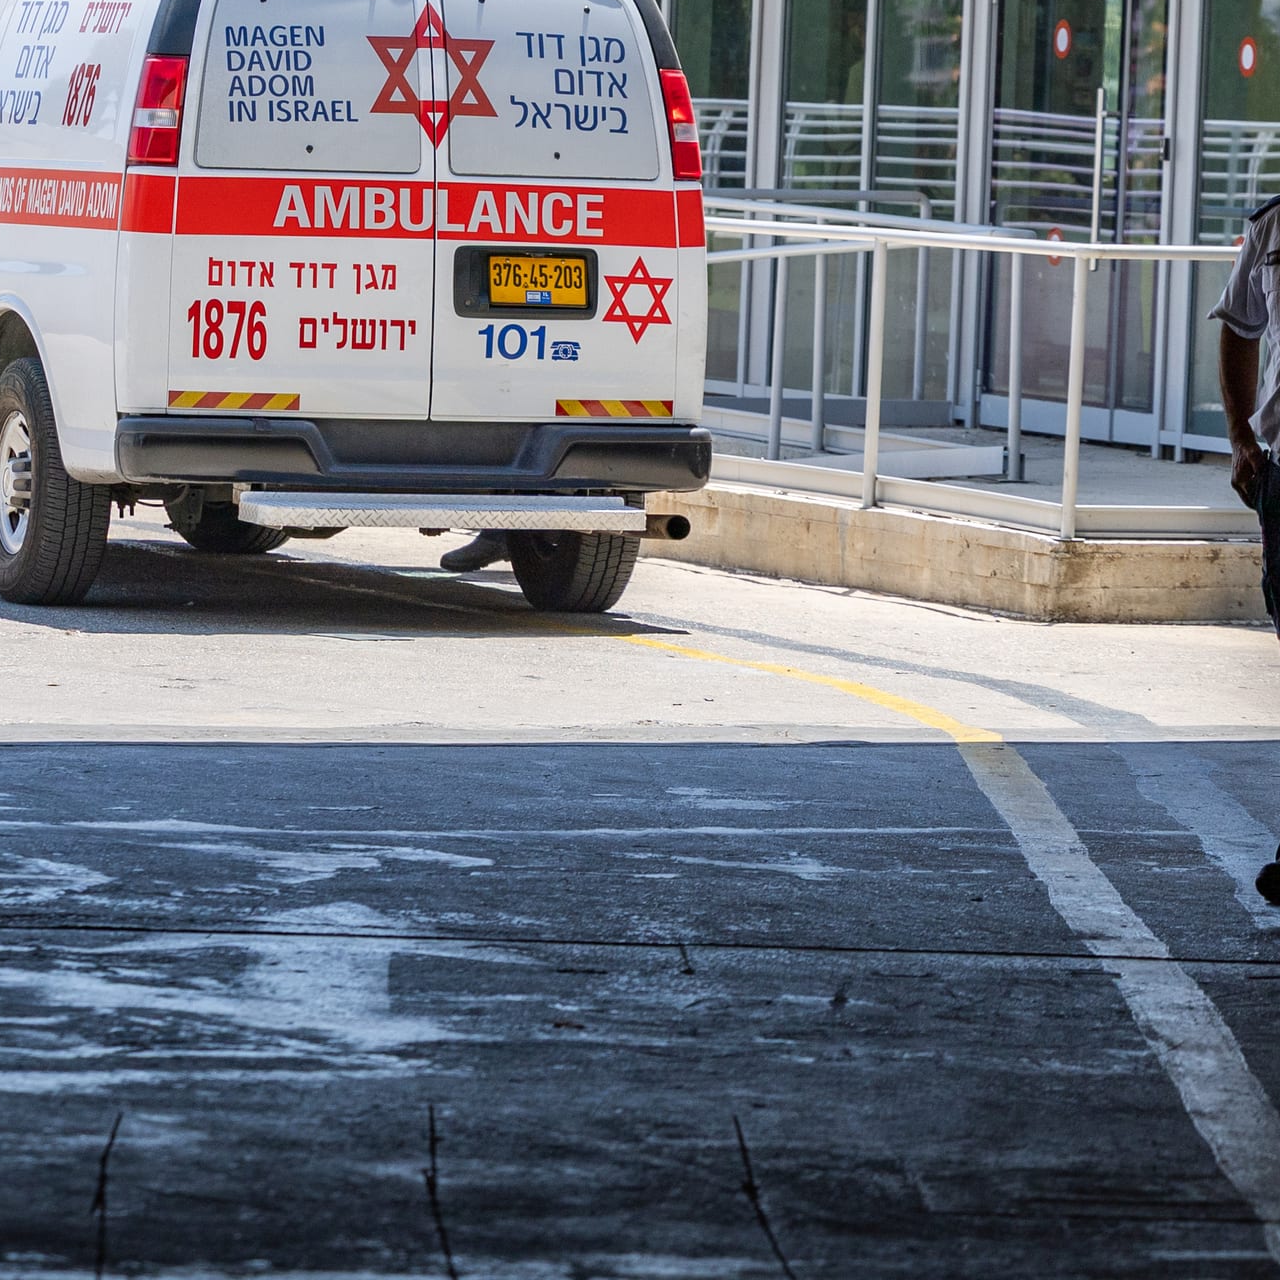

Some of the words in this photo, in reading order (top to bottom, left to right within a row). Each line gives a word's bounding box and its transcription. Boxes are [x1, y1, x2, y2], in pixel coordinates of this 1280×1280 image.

[16, 1, 44, 34] דוד
[37, 1, 70, 41] מגן
[225, 25, 325, 47] MAGEN
[515, 31, 565, 60] דוד
[579, 35, 626, 67] מגן
[14, 45, 56, 79] אדום
[226, 50, 313, 72] DAVID
[61, 63, 101, 127] 1876
[228, 74, 315, 97] ADOM
[554, 68, 628, 99] אדום
[229, 100, 257, 123] IN
[268, 100, 359, 123] ISRAEL
[510, 94, 629, 135] בישראל
[14, 177, 27, 213] OF
[26, 178, 59, 215] MAGEN
[58, 180, 87, 217] DAVID
[86, 181, 119, 219] ADOM
[273, 183, 605, 238] AMBULANCE
[208, 257, 275, 288] אדום
[289, 261, 338, 289] דוד
[352, 263, 397, 294] מגן
[187, 298, 267, 361] 1876
[299, 311, 417, 351] ירושלים
[478, 323, 546, 360] 101
